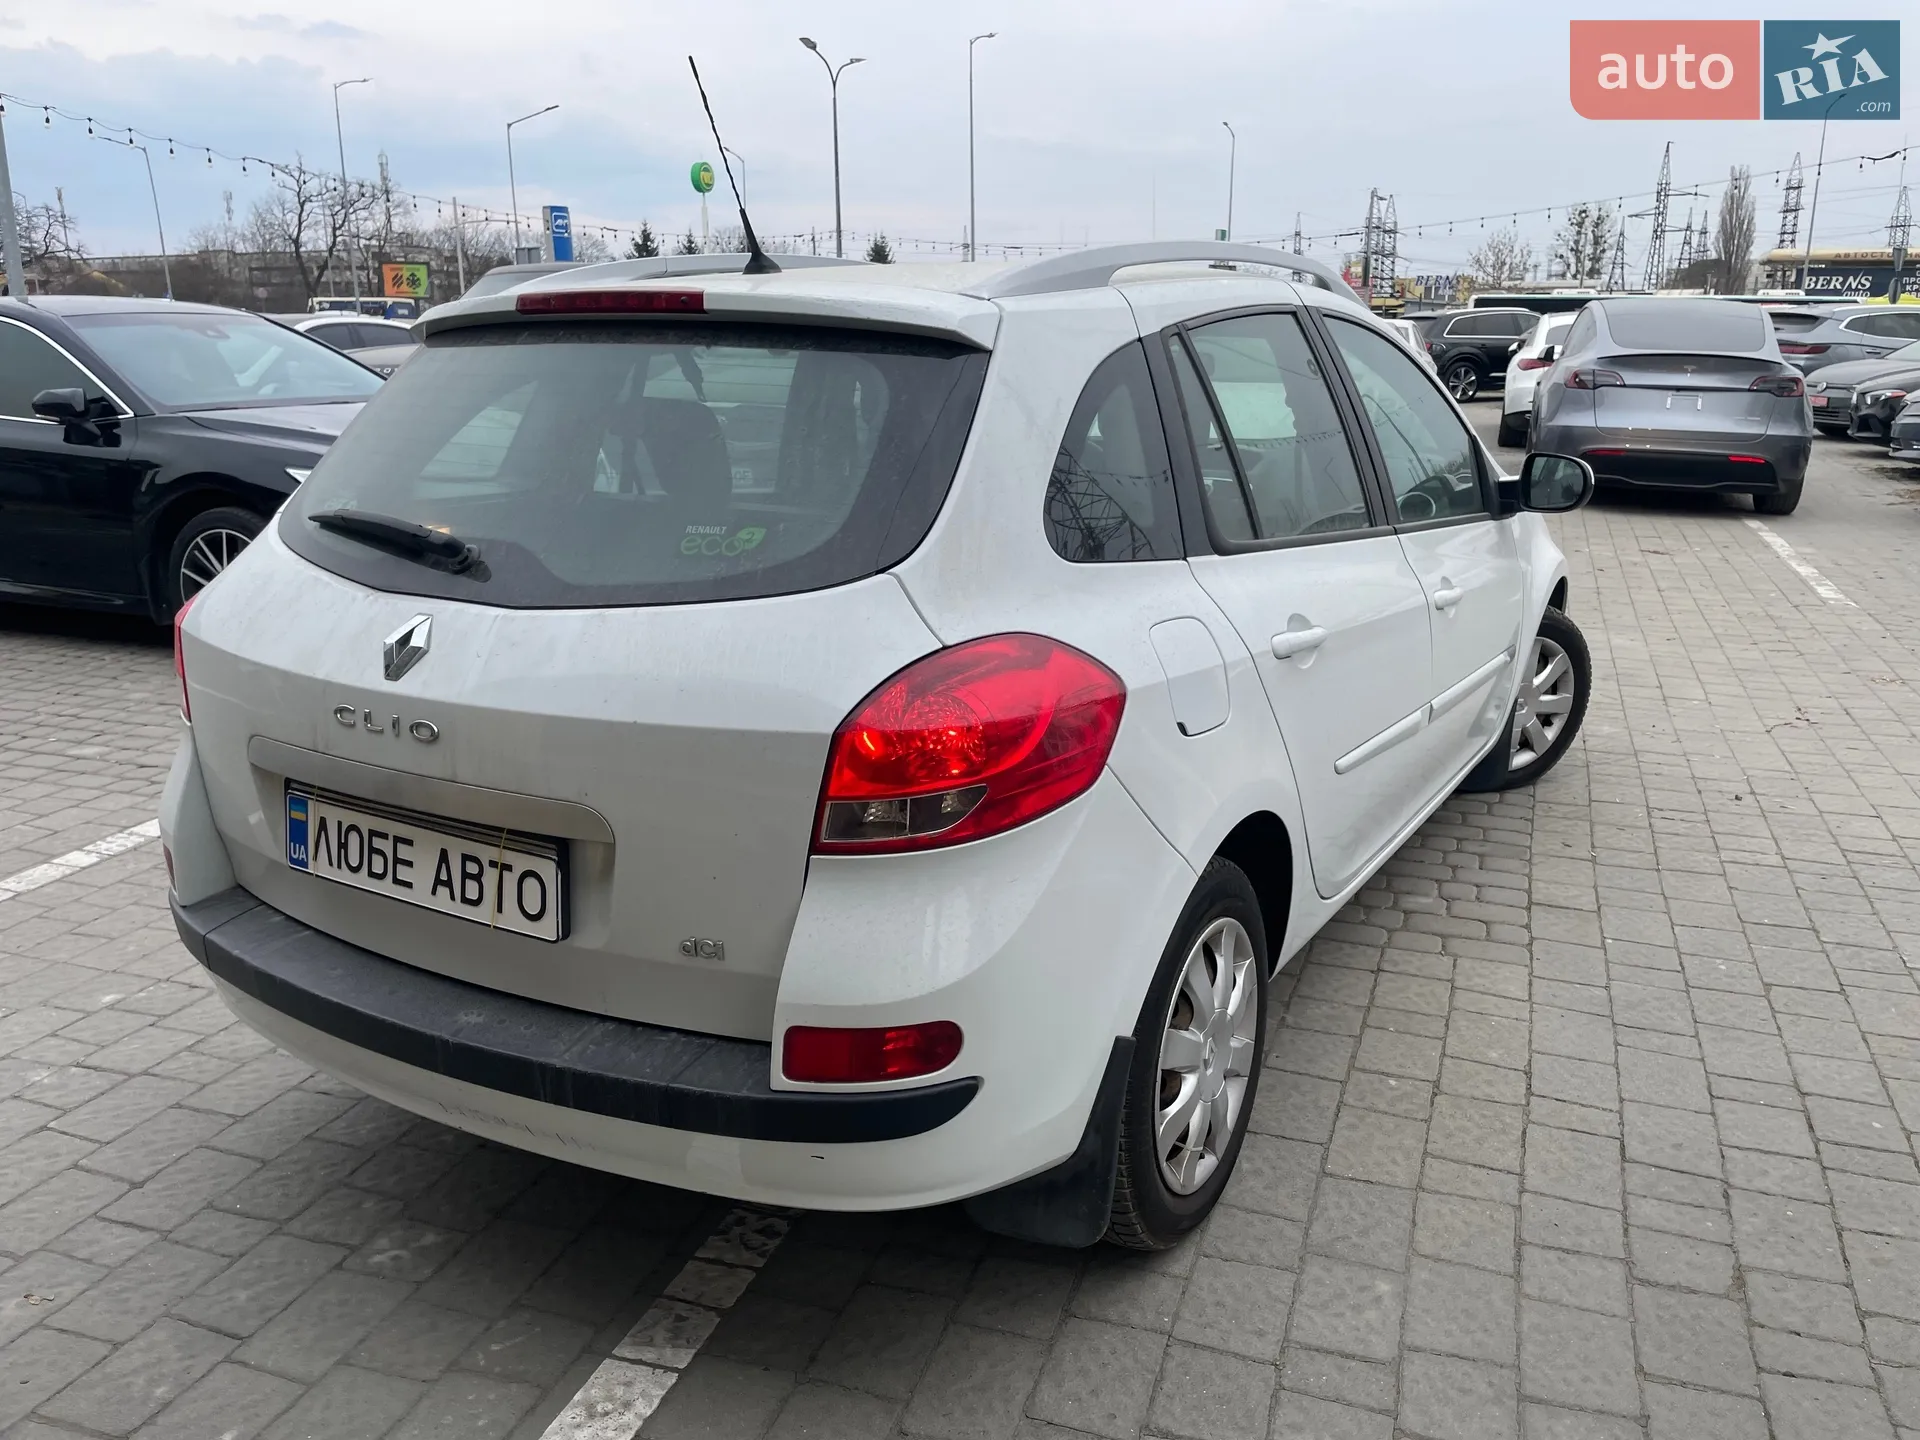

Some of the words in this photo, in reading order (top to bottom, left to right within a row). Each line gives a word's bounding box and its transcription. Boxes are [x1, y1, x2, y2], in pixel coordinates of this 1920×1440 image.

[1804, 270, 1873, 293] BERNS
[1843, 290, 1870, 298] auto
[685, 525, 727, 534] RENAULT
[333, 703, 440, 742] CLIO
[291, 843, 308, 863] UA
[312, 815, 415, 890] ЛЮБЕ
[430, 846, 547, 923] АВТО
